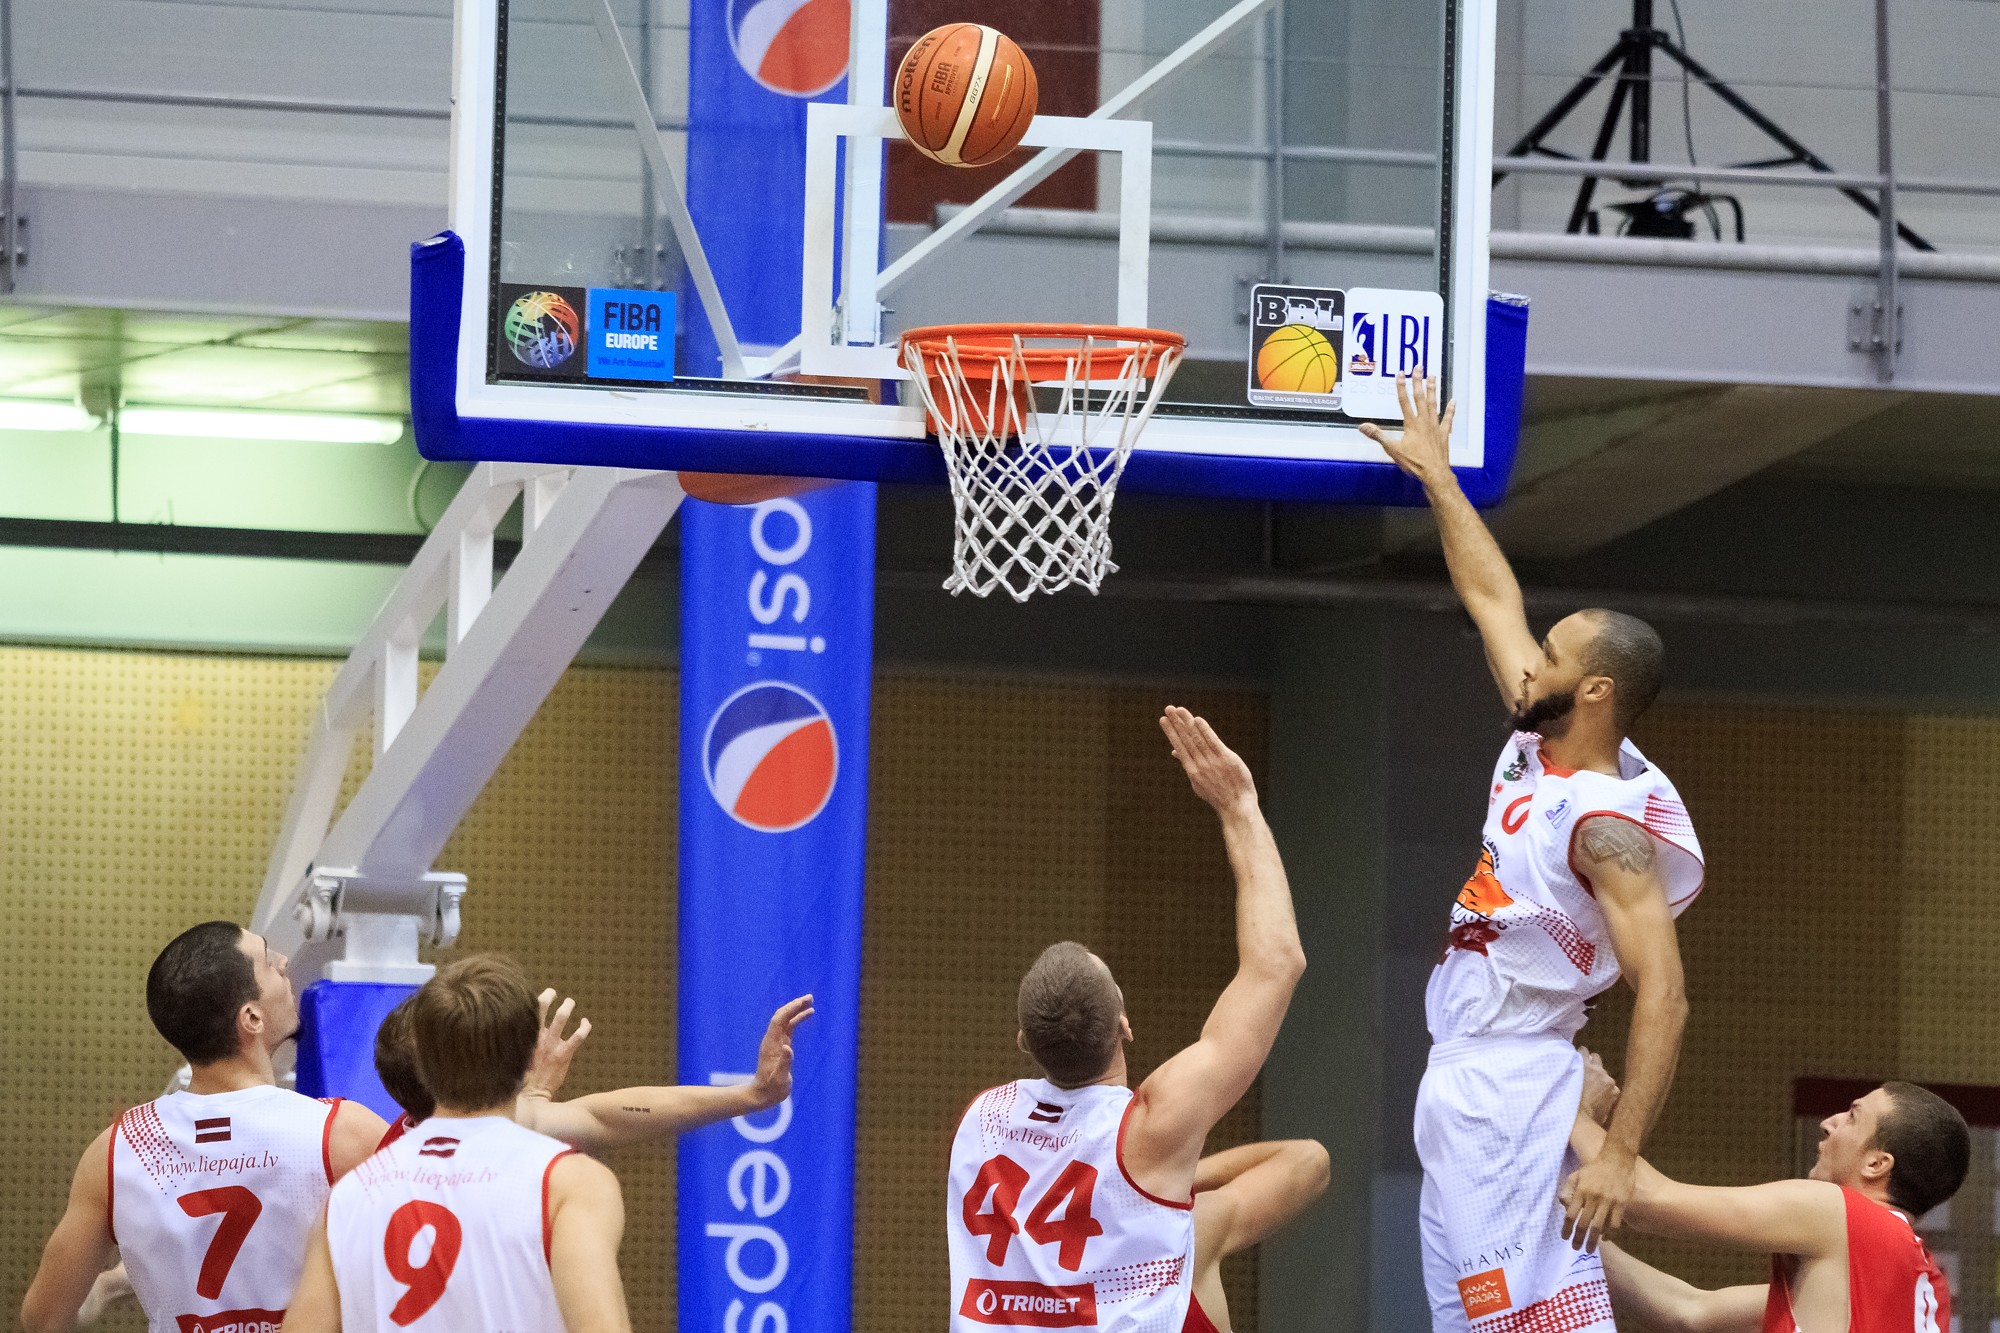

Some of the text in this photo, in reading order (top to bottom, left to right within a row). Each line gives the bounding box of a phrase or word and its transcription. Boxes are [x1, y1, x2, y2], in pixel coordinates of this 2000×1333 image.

[901, 37, 936, 113] molten
[931, 62, 953, 94] FIBA
[604, 302, 661, 332] FIBA
[1257, 295, 1343, 331] BBL
[605, 333, 658, 351] EUROPE
[155, 1150, 279, 1176] www.liepaja.lv
[962, 1154, 1104, 1272] 44
[176, 1185, 263, 1300] 7
[384, 1199, 463, 1328] 9
[1000, 1294, 1081, 1315] TRIOBET
